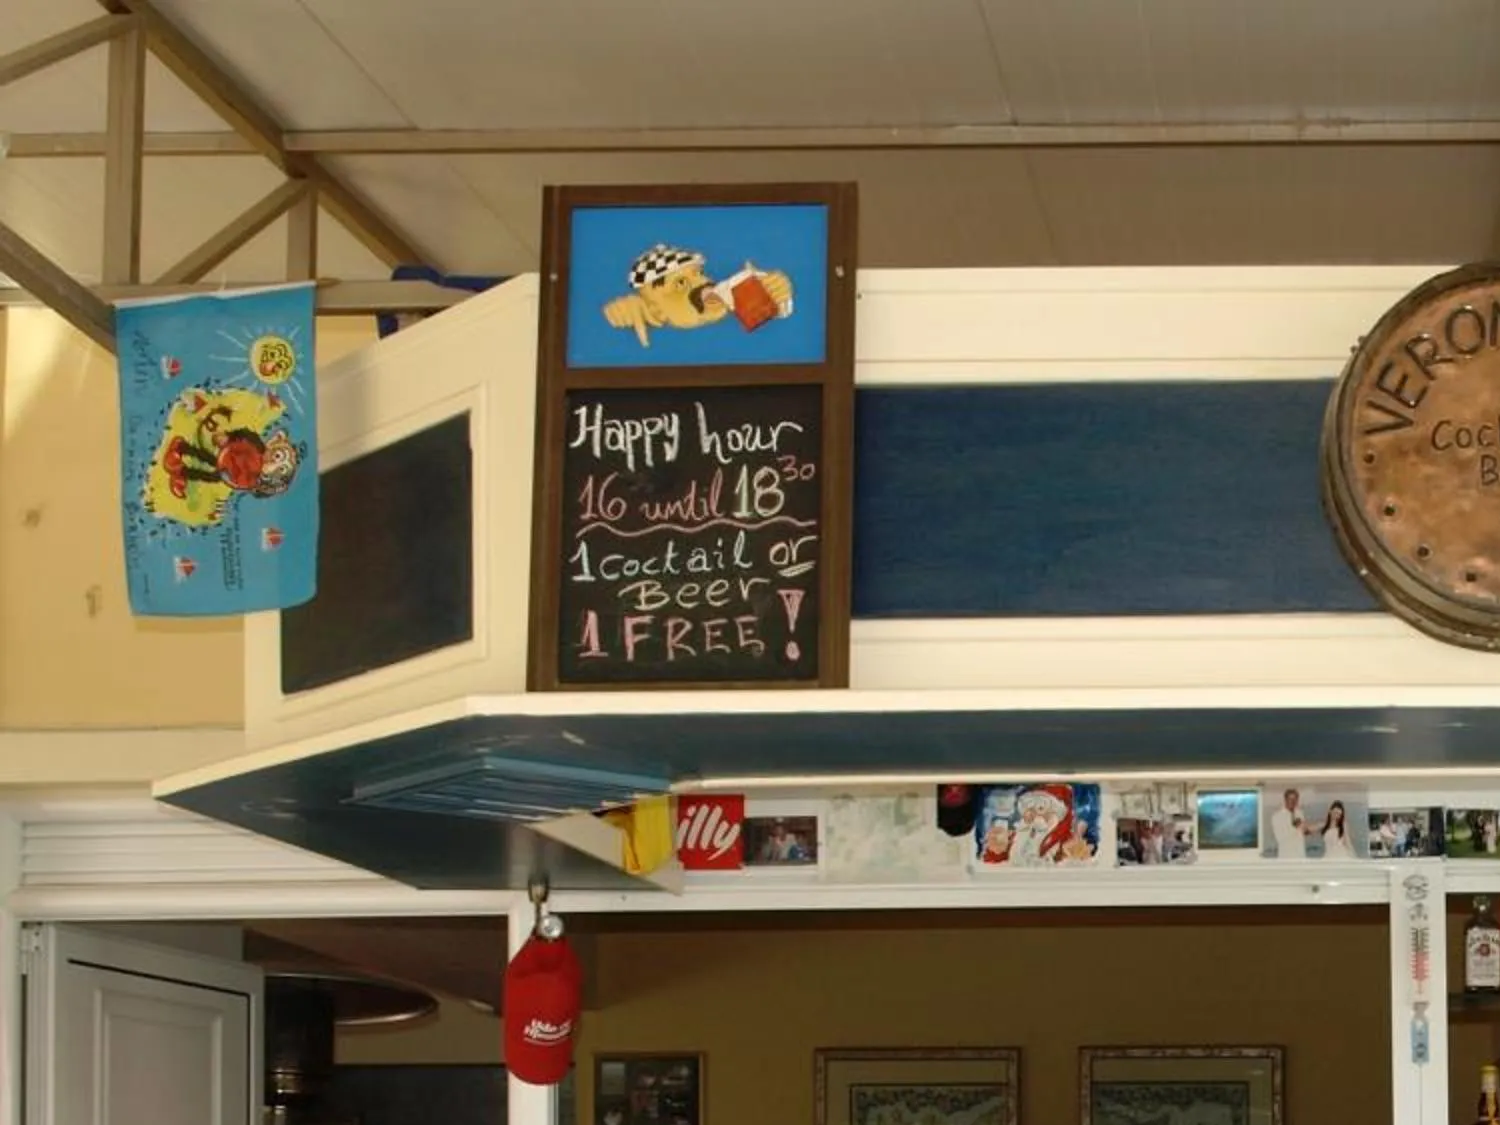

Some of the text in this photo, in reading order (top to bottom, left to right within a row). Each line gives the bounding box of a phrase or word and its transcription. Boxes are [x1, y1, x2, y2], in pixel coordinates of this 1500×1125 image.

[569, 402, 803, 472] Happy hour
[578, 471, 627, 520] 16
[639, 467, 724, 521] until
[769, 535, 818, 565] or
[617, 577, 771, 611] Beer
[578, 610, 609, 658] 1
[676, 803, 741, 861] illy
